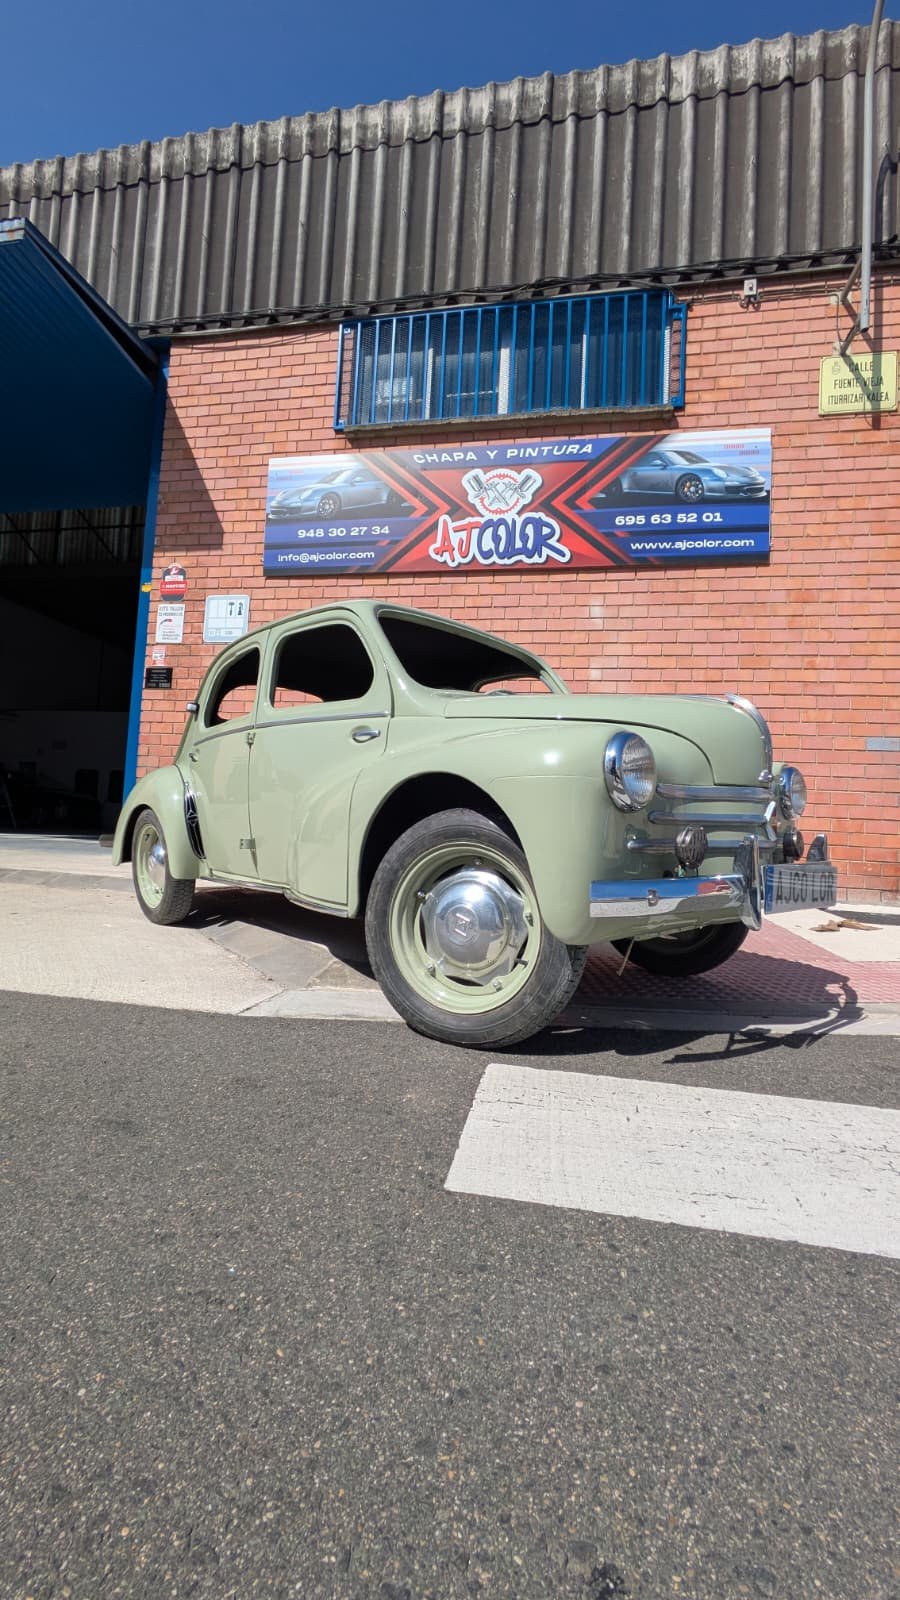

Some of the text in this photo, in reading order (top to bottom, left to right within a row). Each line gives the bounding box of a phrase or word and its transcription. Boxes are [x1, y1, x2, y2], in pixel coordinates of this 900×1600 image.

[849, 361, 874, 372] CALLE
[834, 376, 884, 389] FUENTE VIEJA
[828, 391, 889, 405] ITURRIZAR KALEA
[413, 442, 593, 465] CHAPA Y PINTURA
[615, 512, 723, 526] 695 63 52 01
[297, 525, 391, 539] 948 30 27 34
[433, 515, 569, 563] AJCOLOR
[631, 537, 755, 551] www.ajcolor.com
[277, 549, 375, 563] info@ajcolor.com
